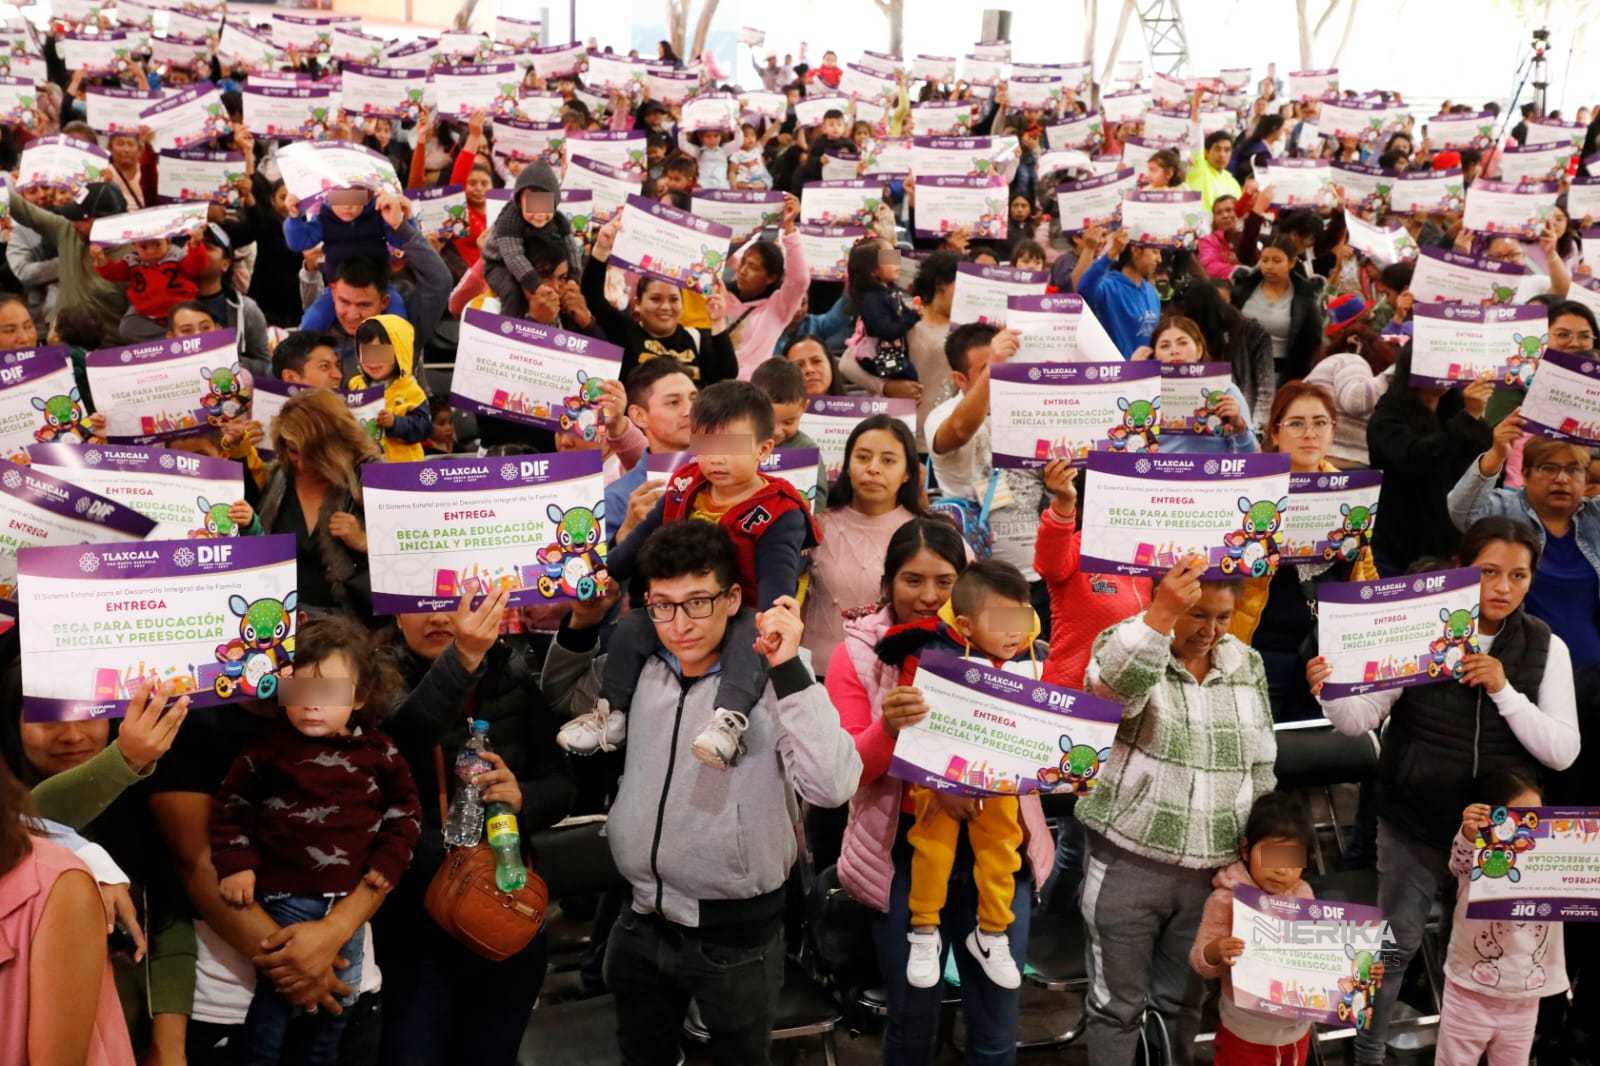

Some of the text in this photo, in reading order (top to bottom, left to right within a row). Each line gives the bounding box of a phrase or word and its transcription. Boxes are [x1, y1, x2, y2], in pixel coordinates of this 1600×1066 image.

[183, 338, 201, 352] DIF
[567, 336, 589, 351] DIF
[509, 353, 543, 366] ENTREGA
[1, 367, 23, 381] DIF
[1100, 366, 1121, 377] DIF
[348, 393, 364, 403] DIF
[872, 401, 888, 412] DIF
[1061, 408, 1114, 417] EDUCACIÓN
[0, 412, 33, 425] ACIÓN
[104, 451, 149, 460] TLAXCALA
[177, 456, 200, 471] DIF
[520, 460, 549, 476] DIF
[1221, 459, 1246, 473] DIF
[440, 466, 489, 476] TLAXCALA
[25, 476, 69, 499] TLAXCALA
[1329, 475, 1349, 488] DIF
[106, 487, 153, 496] ENTREGA
[1151, 496, 1195, 504] ENTREGA
[89, 500, 115, 518] DIF
[444, 510, 496, 521] ENTREGA
[1109, 508, 1136, 516] BECA
[1171, 508, 1233, 518] EDUCACIÓN
[8, 519, 48, 538] ENTREGA
[1110, 518, 1231, 528] INICIAL Y PREESCOLAR
[396, 521, 544, 540] BECA PARA EDUCACIÓN
[399, 533, 543, 551] INICIAL Y PREESCOLAR
[102, 551, 160, 561] TLAXCALA
[197, 545, 232, 563] DIF
[1374, 582, 1407, 592] TLAXCALA
[1426, 576, 1446, 589] DIF
[106, 600, 167, 612] ENTREGA
[53, 613, 224, 634] BECA PARA EDUCACIÓN
[1374, 614, 1407, 625] ENTREGA
[56, 627, 224, 647] INICIAL Y PREESCOLAR
[983, 672, 1024, 691] TLAXCALA
[1049, 691, 1076, 709] DIF
[974, 710, 1016, 728] ENTREGA
[930, 711, 1053, 753] BECA PARA EDUCACIÓN
[929, 721, 1049, 762] INICIAL Y PREESCOLAR
[1323, 906, 1344, 918] DIF
[1511, 904, 1536, 916] DIF
